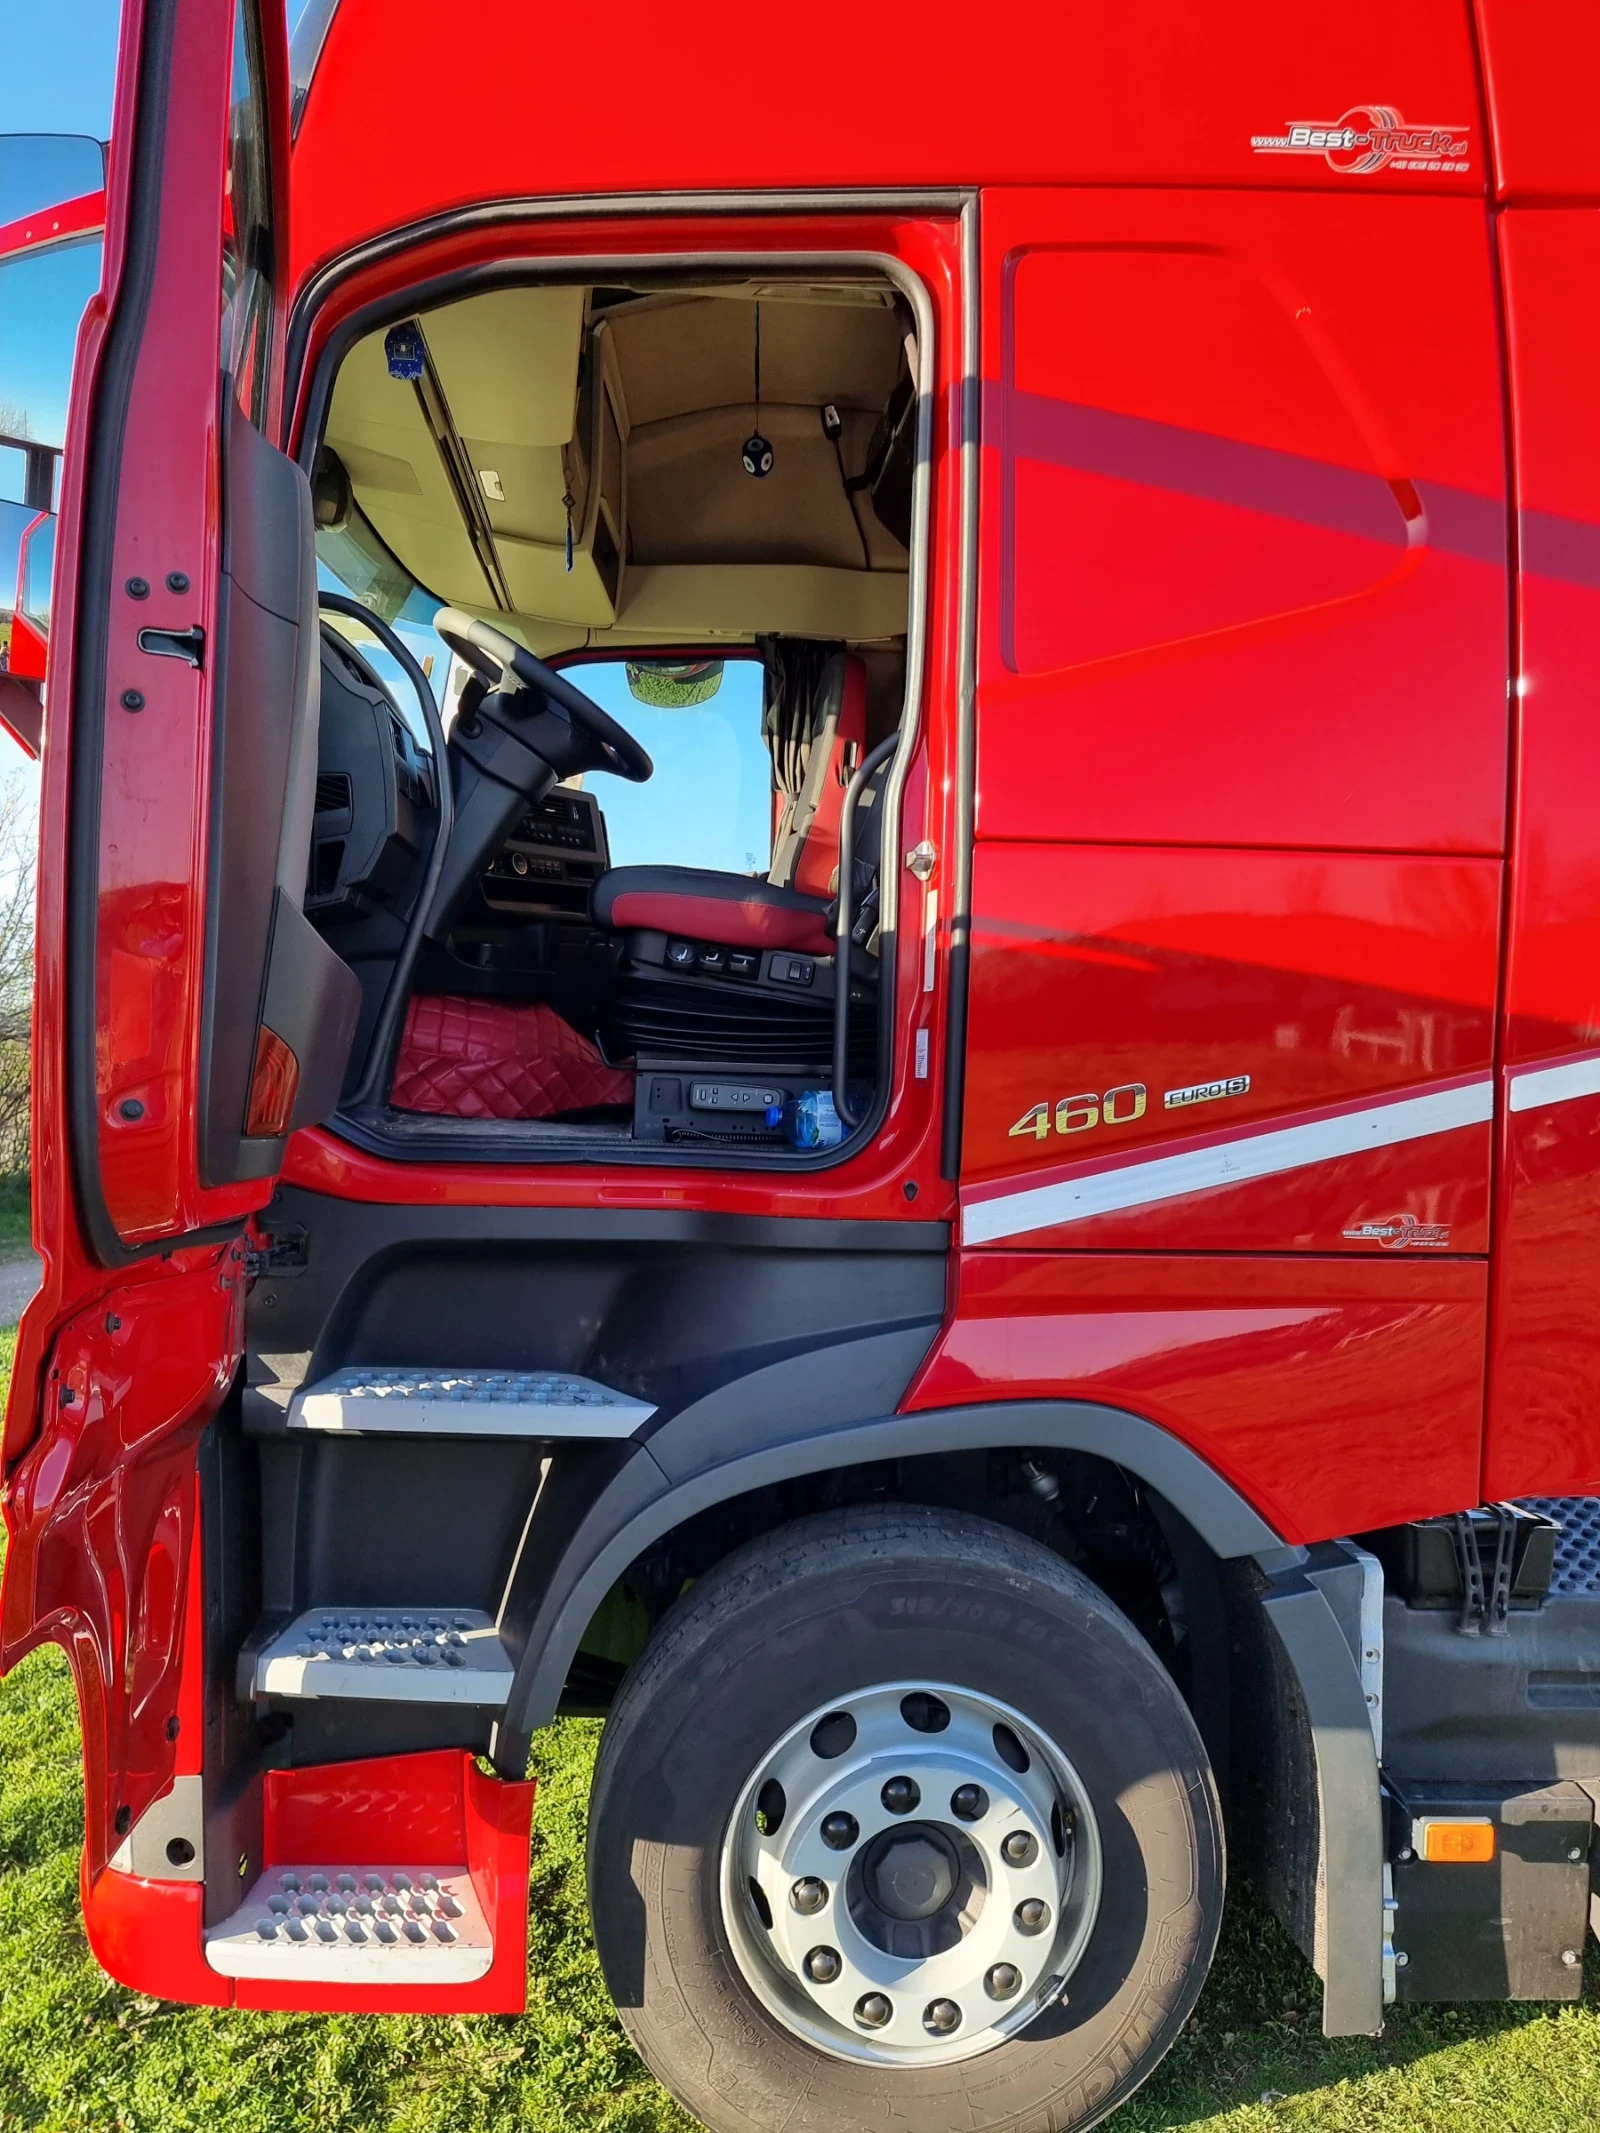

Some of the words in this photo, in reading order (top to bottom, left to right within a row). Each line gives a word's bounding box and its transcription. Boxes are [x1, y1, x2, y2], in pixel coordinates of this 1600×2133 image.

[1008, 1083, 1147, 1140] 460
[1169, 1084, 1222, 1105] EURO
[723, 1999, 766, 2048] MICHELIN
